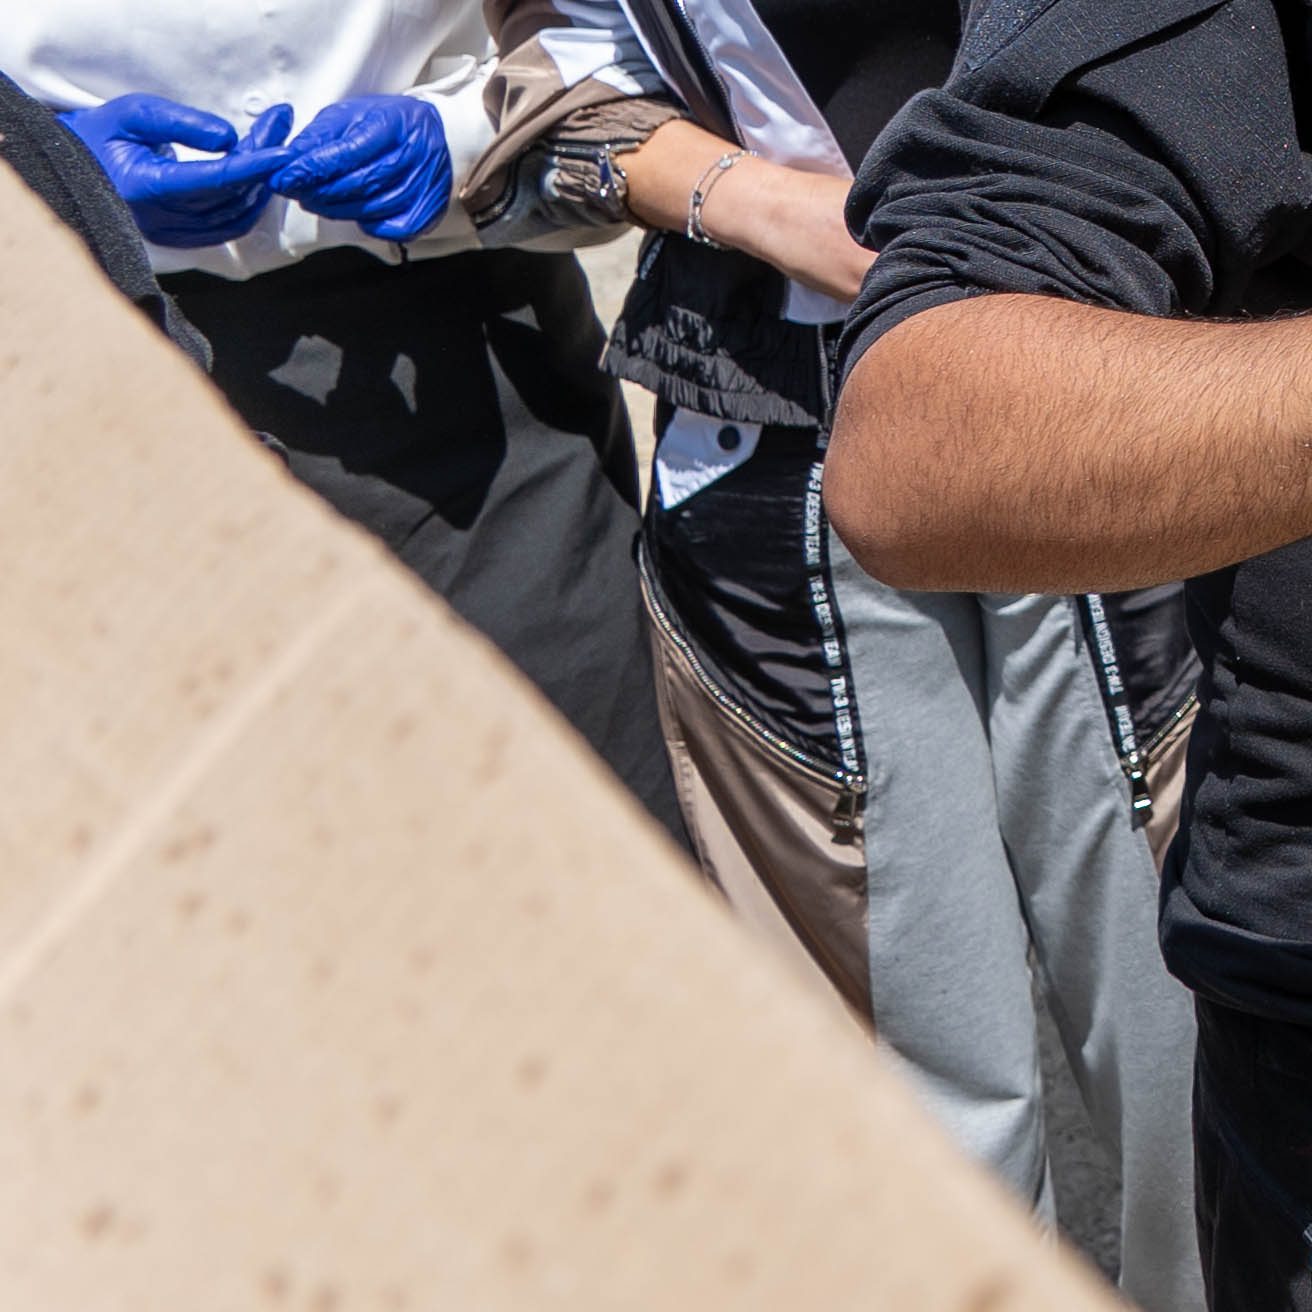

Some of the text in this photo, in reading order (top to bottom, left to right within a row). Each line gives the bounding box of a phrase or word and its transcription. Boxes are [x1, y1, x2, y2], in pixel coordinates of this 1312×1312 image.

[805, 491, 821, 534] DESIGN
[805, 534, 821, 565] TEAM
[1094, 621, 1116, 665] DESIGN
[1104, 665, 1125, 696] TW-3
